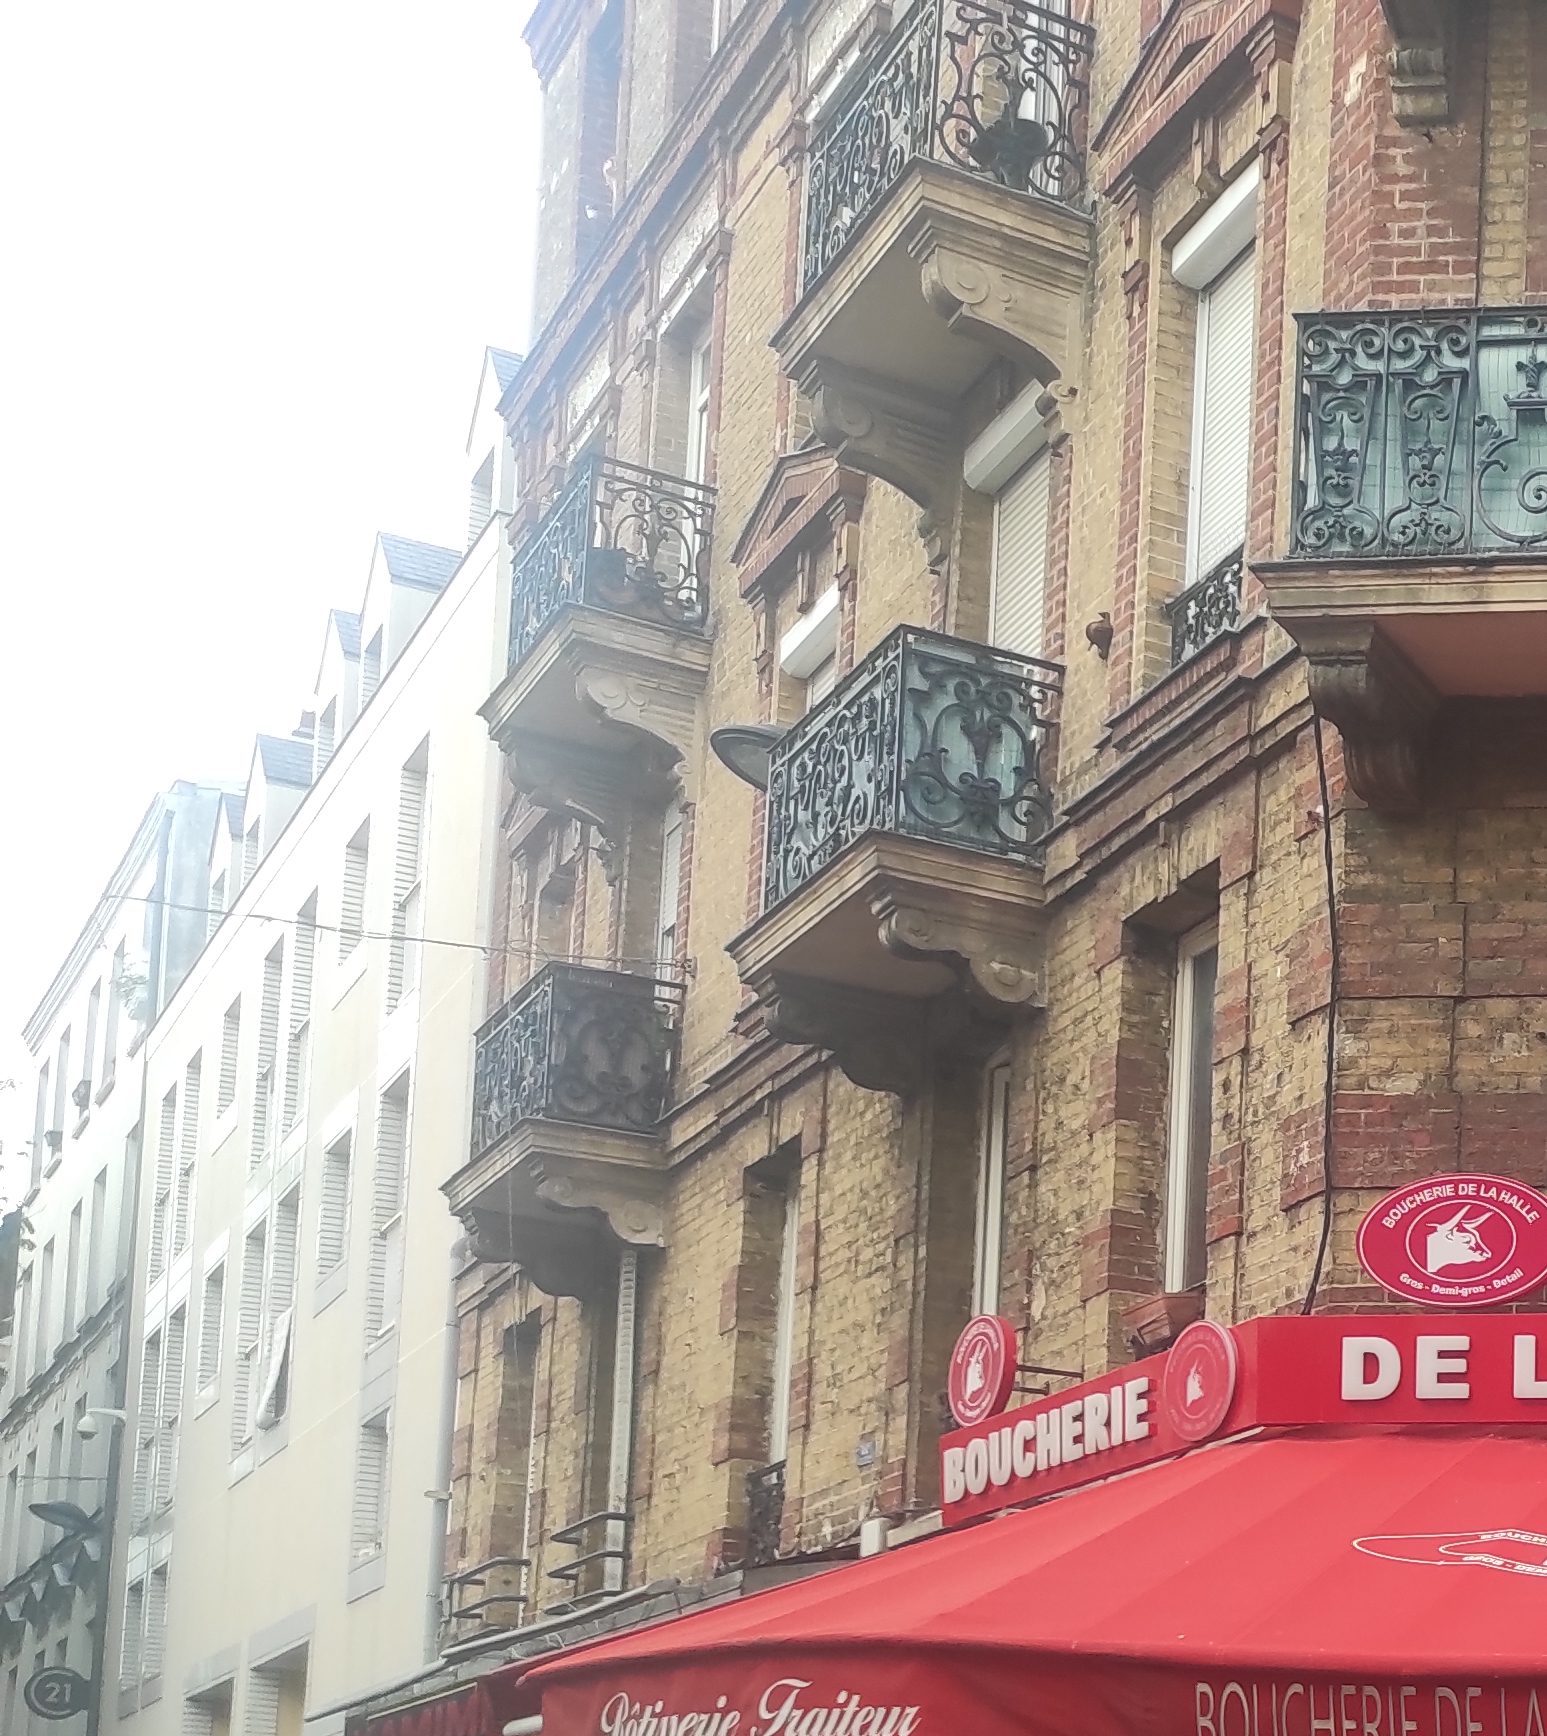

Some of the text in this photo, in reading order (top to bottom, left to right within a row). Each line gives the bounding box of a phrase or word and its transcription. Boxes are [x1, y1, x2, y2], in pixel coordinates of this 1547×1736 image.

[1381, 1183, 1540, 1229] BOUCHERIE DE LA HALLE
[1399, 1272, 1424, 1290] Gros
[1340, 1334, 1473, 1402] DE
[943, 1376, 1150, 1504] BOUCHERIE
[45, 1682, 72, 1704] 21
